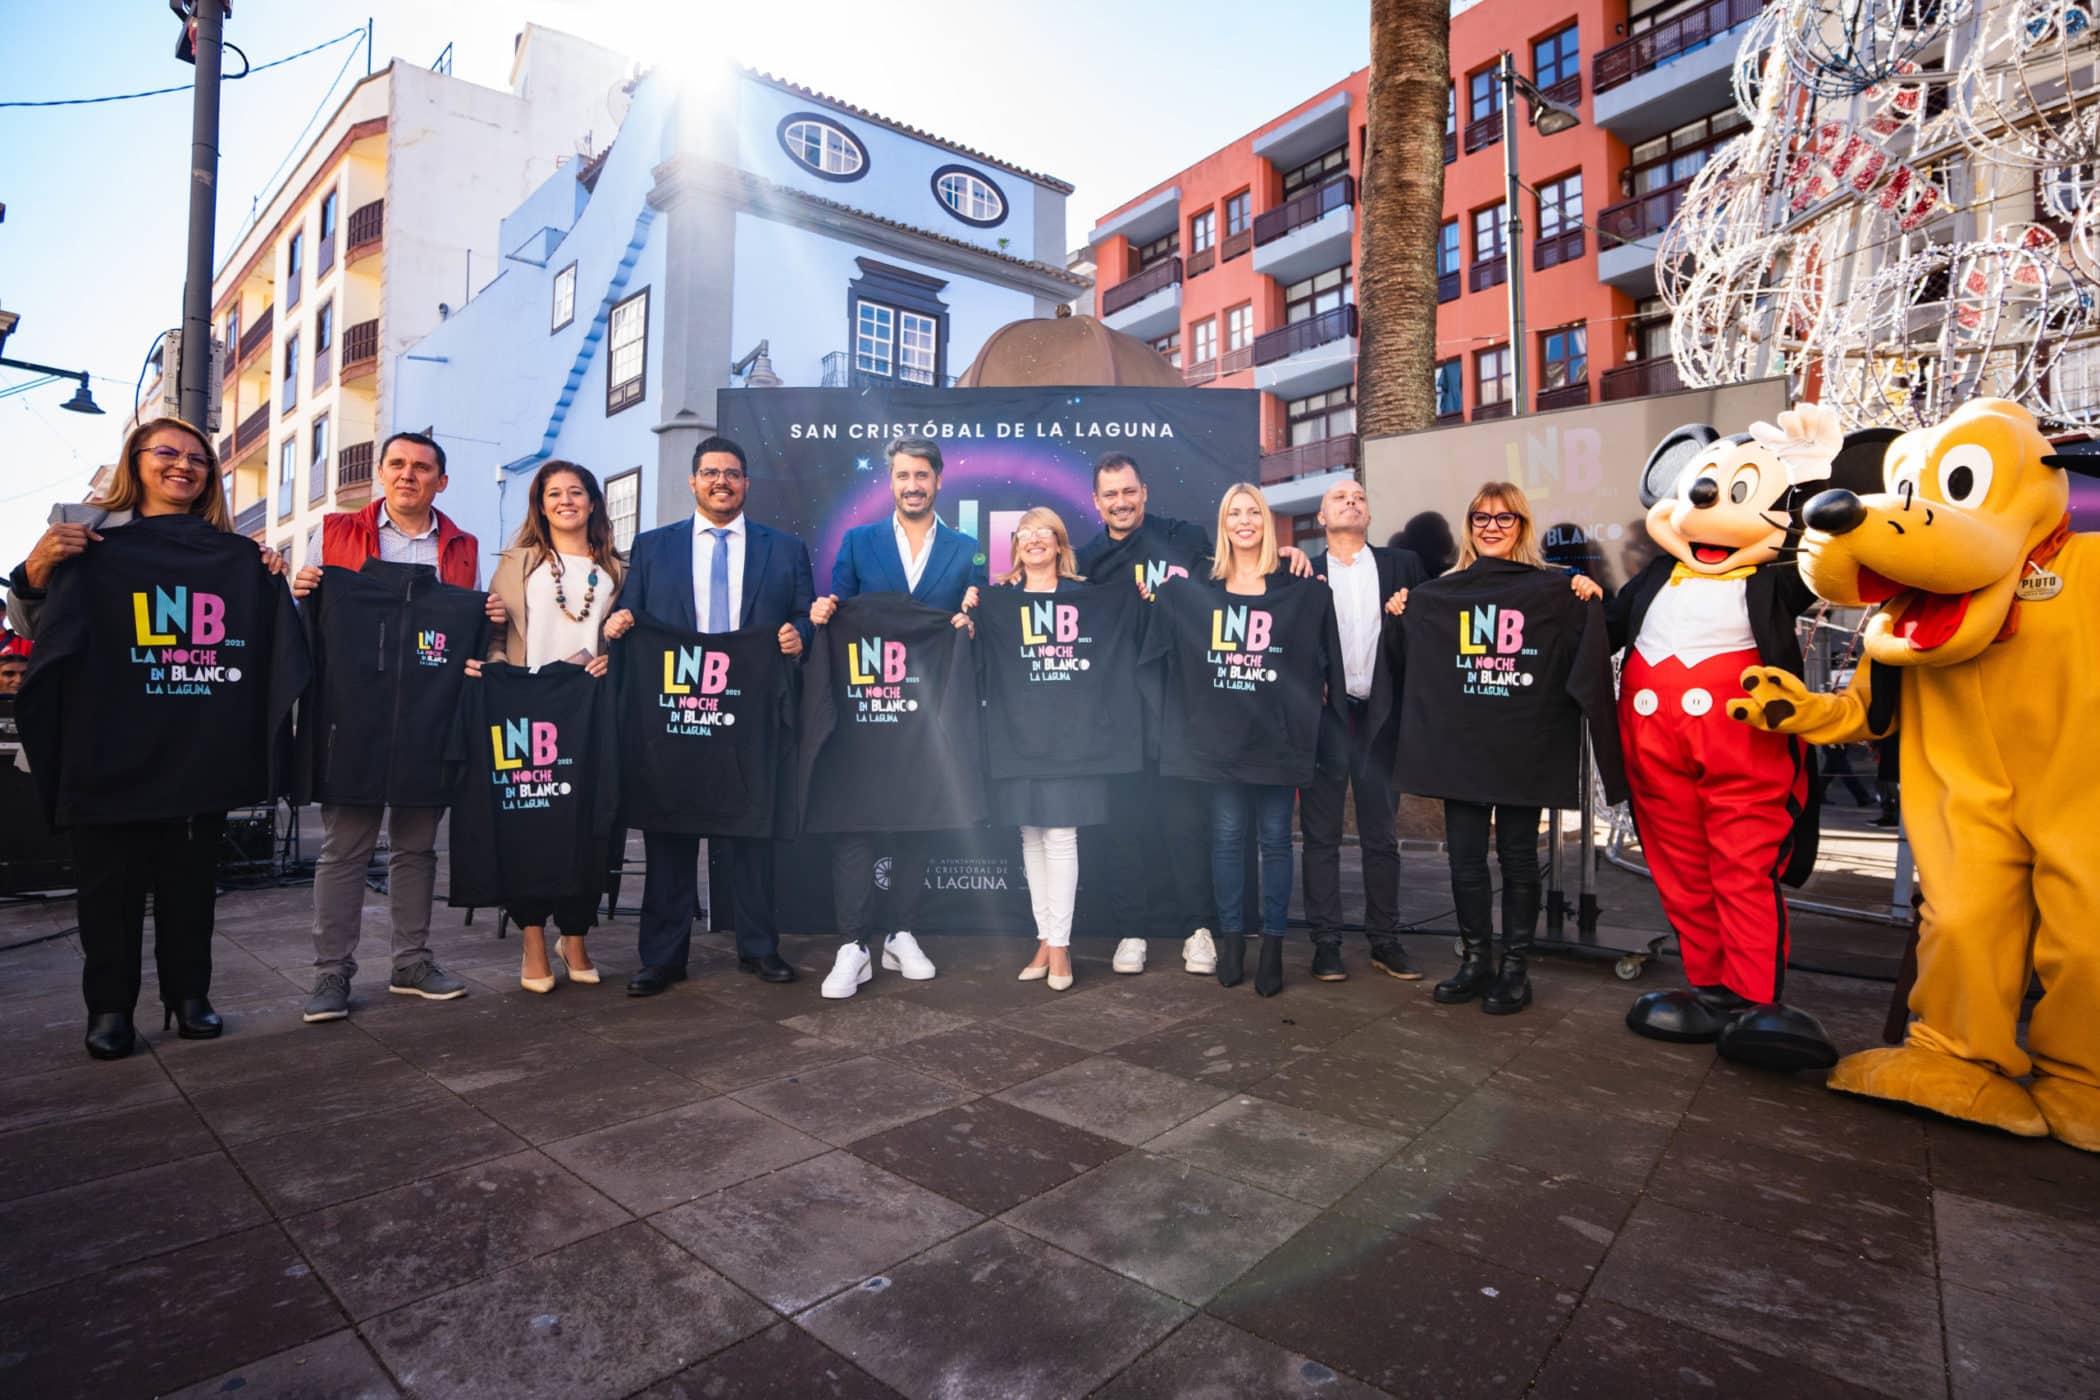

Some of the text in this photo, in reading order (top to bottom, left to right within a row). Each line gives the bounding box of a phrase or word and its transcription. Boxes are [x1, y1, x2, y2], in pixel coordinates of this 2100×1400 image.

[790, 420, 1174, 439] SAN CRISTÓBAL DE LA LAGUNA
[1505, 424, 1602, 500] LNB
[1545, 522, 1623, 547] BLANCO
[2021, 576, 2056, 589] PLUTO
[132, 584, 226, 646] LNB
[1020, 600, 1079, 646] LNB
[1211, 605, 1273, 652] LNB
[1459, 604, 1525, 655] LNB
[418, 629, 446, 650] LNB
[130, 647, 217, 666] LA NOCHE
[1020, 645, 1074, 658] LA NOCHE
[1207, 650, 1263, 668] LA NOCHE
[847, 636, 906, 685] LNB
[1044, 657, 1091, 671] BLANCO
[1456, 655, 1516, 672] LA NOCHE
[150, 665, 242, 682] EN BLANCO
[663, 645, 730, 695] LNB
[1029, 671, 1071, 681] LA LAGUNA
[1230, 665, 1278, 682] BLANCO
[1480, 669, 1534, 687] BLANCO
[145, 683, 212, 695] LA LAGUNA
[847, 685, 901, 699] LA NOCHE
[1213, 679, 1256, 692] LA LAGUNA
[1463, 684, 1510, 697] LA LAGUNA
[659, 694, 719, 712] LA NOCHE
[871, 699, 919, 713] BLANCO
[683, 709, 736, 726] BLANCO
[856, 713, 899, 723] LA LAGUNA
[666, 723, 712, 737] LA LAGUNA
[490, 717, 559, 771] LNB
[492, 769, 553, 785] LA NOCHE
[520, 782, 572, 798] BLANCO
[502, 799, 551, 810] LA LAGUNA
[935, 865, 992, 874] CRISTÓBAL
[996, 866, 1008, 874] DE
[937, 876, 1008, 890] LAGUNA
